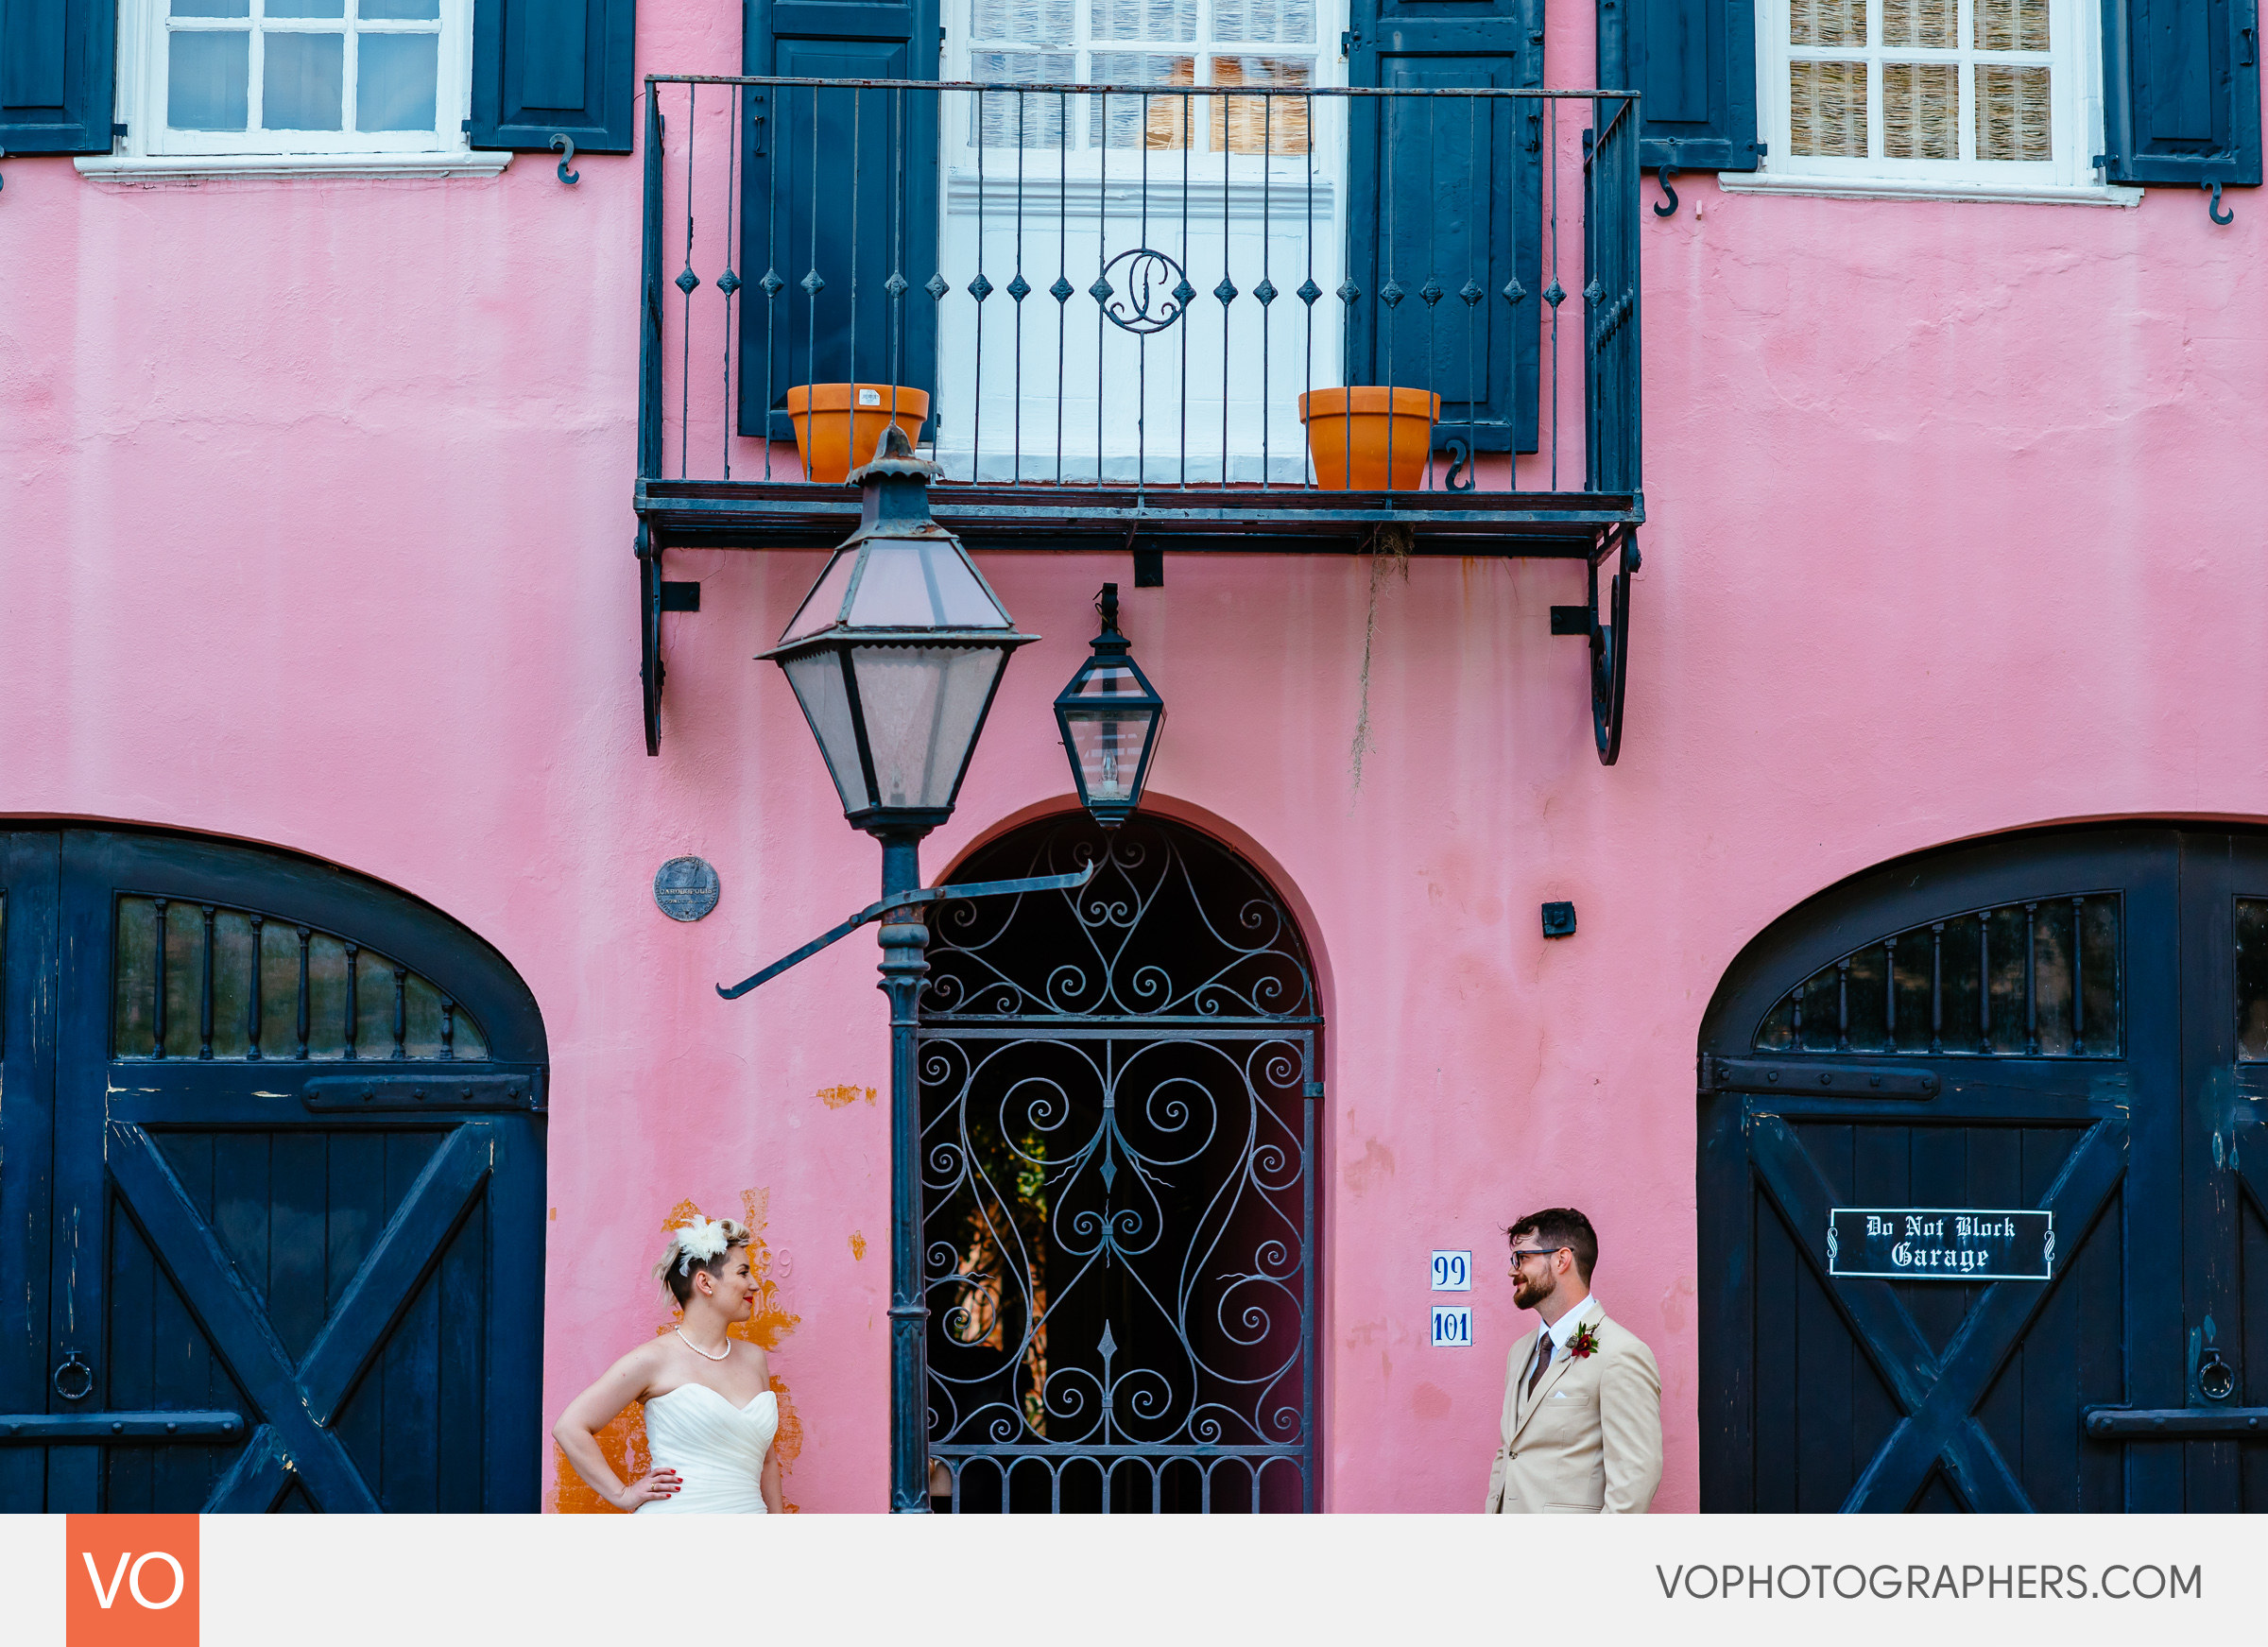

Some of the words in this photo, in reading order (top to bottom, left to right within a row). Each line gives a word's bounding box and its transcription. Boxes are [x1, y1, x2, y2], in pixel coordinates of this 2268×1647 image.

[1866, 1215, 1894, 1237] Do
[1905, 1215, 1944, 1237] Not
[1955, 1215, 2016, 1237] Block
[1434, 1256, 1466, 1285] 99
[1891, 1241, 1989, 1273] Garage
[1434, 1312, 1469, 1341] 101
